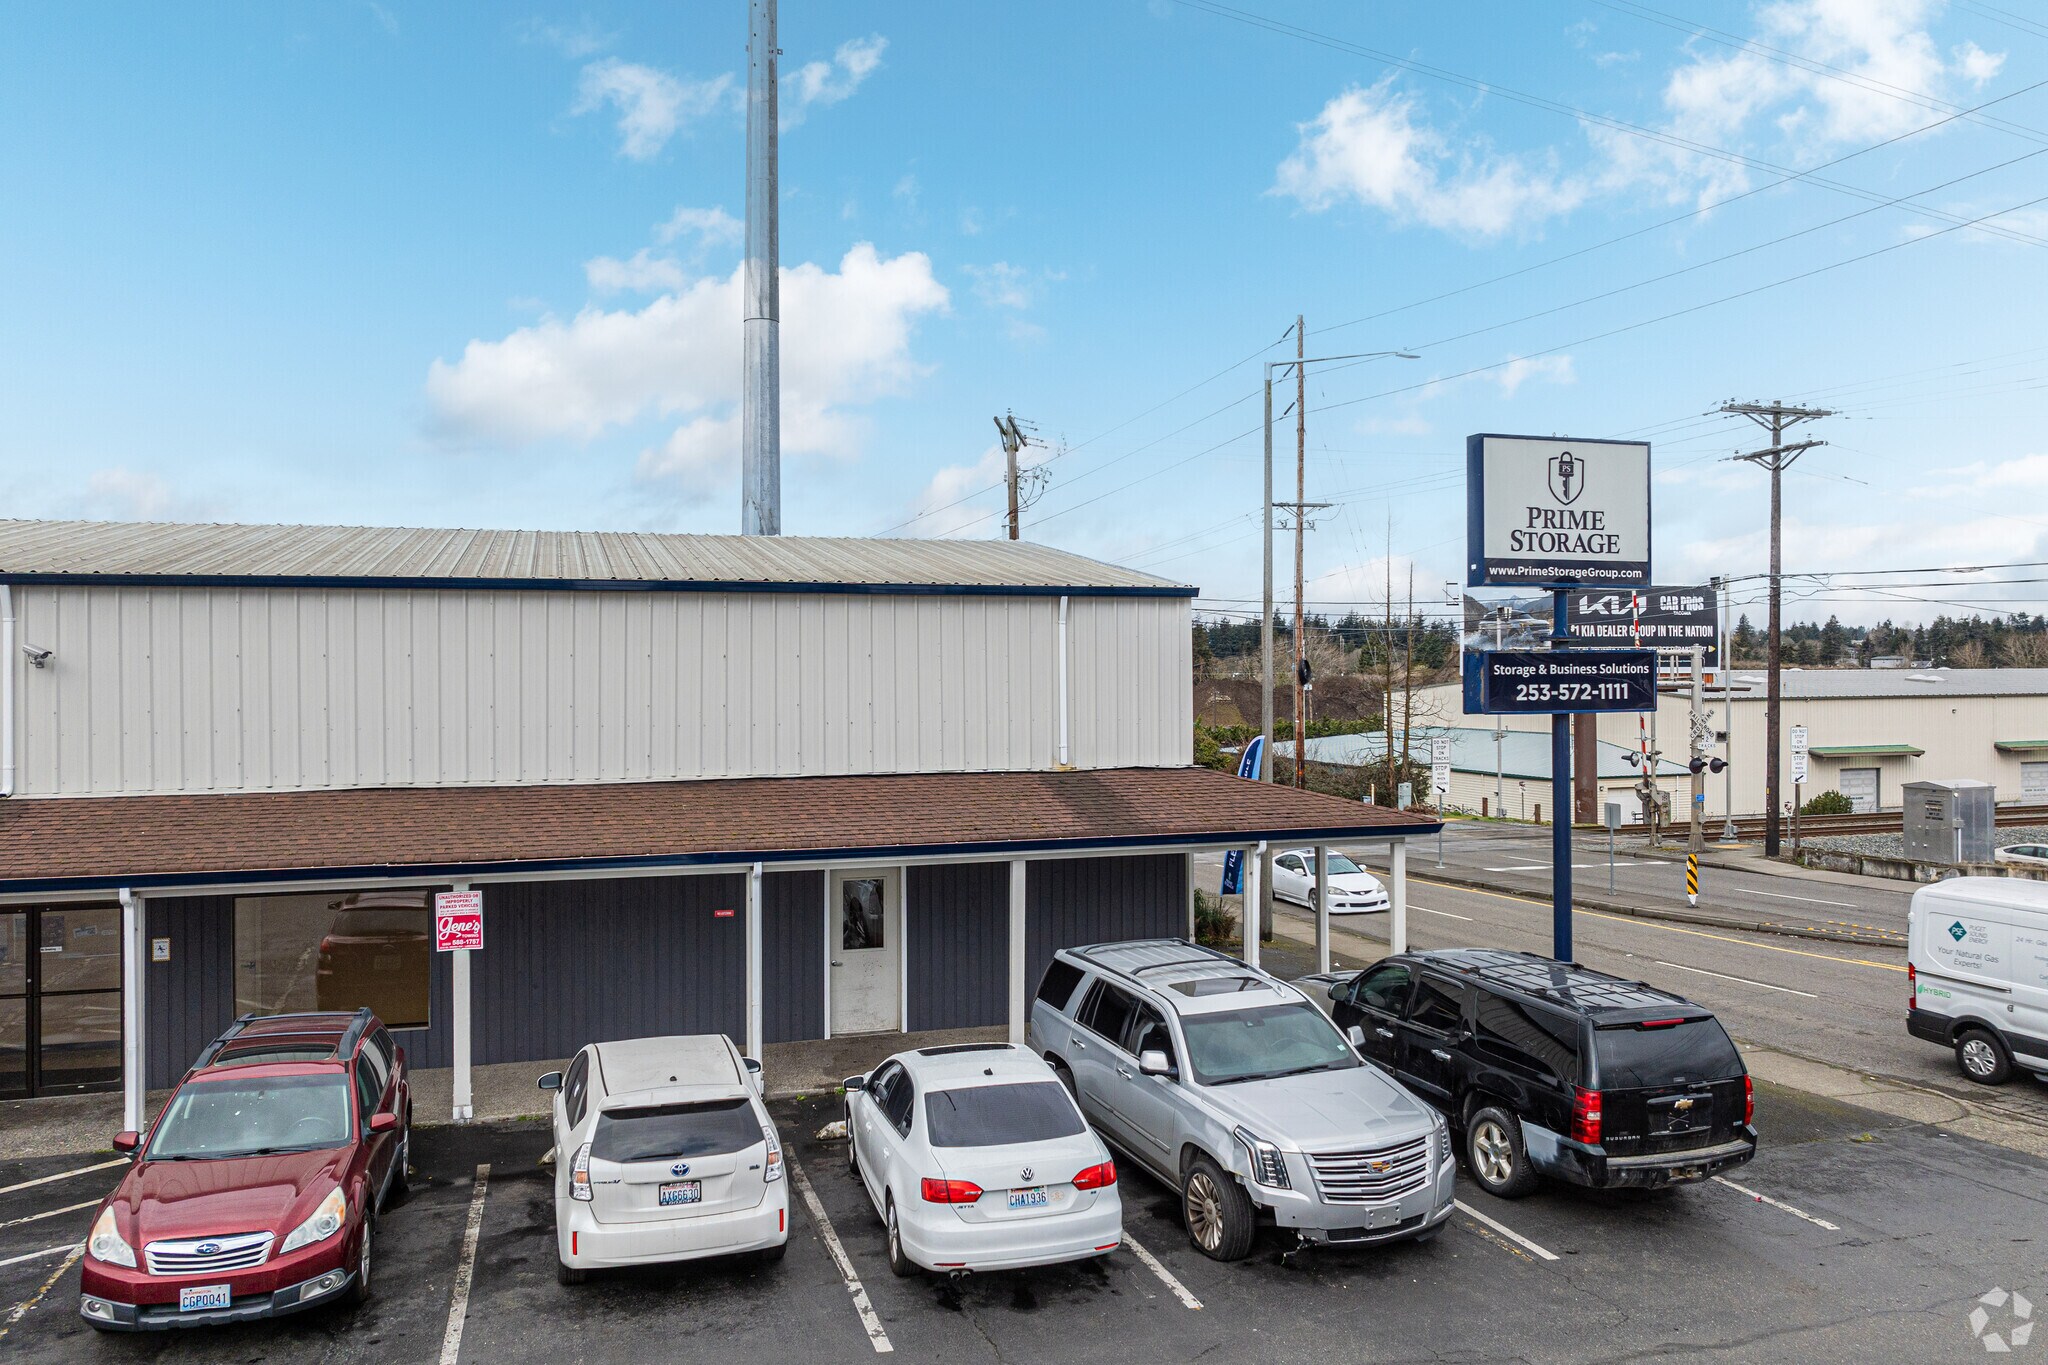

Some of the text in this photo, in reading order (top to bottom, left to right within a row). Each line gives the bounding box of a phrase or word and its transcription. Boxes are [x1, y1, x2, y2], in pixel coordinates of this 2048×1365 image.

[1526, 506, 1606, 531] PRIME
[1510, 529, 1621, 554] STORAGE
[1489, 565, 1642, 579] www.PrimeStorageGroup.com
[1660, 595, 1705, 611] CAR PROS
[1581, 624, 1596, 637] KIA
[1597, 624, 1628, 637] DEALER
[1657, 624, 1667, 637] IN
[1668, 625, 1683, 637] THE
[1684, 625, 1714, 638] NATION
[1493, 663, 1650, 678] Storage & Business Solutions
[1516, 683, 1629, 701] 253-572-1111
[1951, 926, 1964, 937] PSE
[1937, 946, 1999, 964] Your Natural Gas
[1953, 958, 1983, 969] Experts!
[1923, 986, 1952, 999] HYBRID
[661, 1188, 699, 1203] AXG6630
[1009, 1191, 1047, 1207] CHA1936
[182, 1293, 226, 1308] CGP0041
